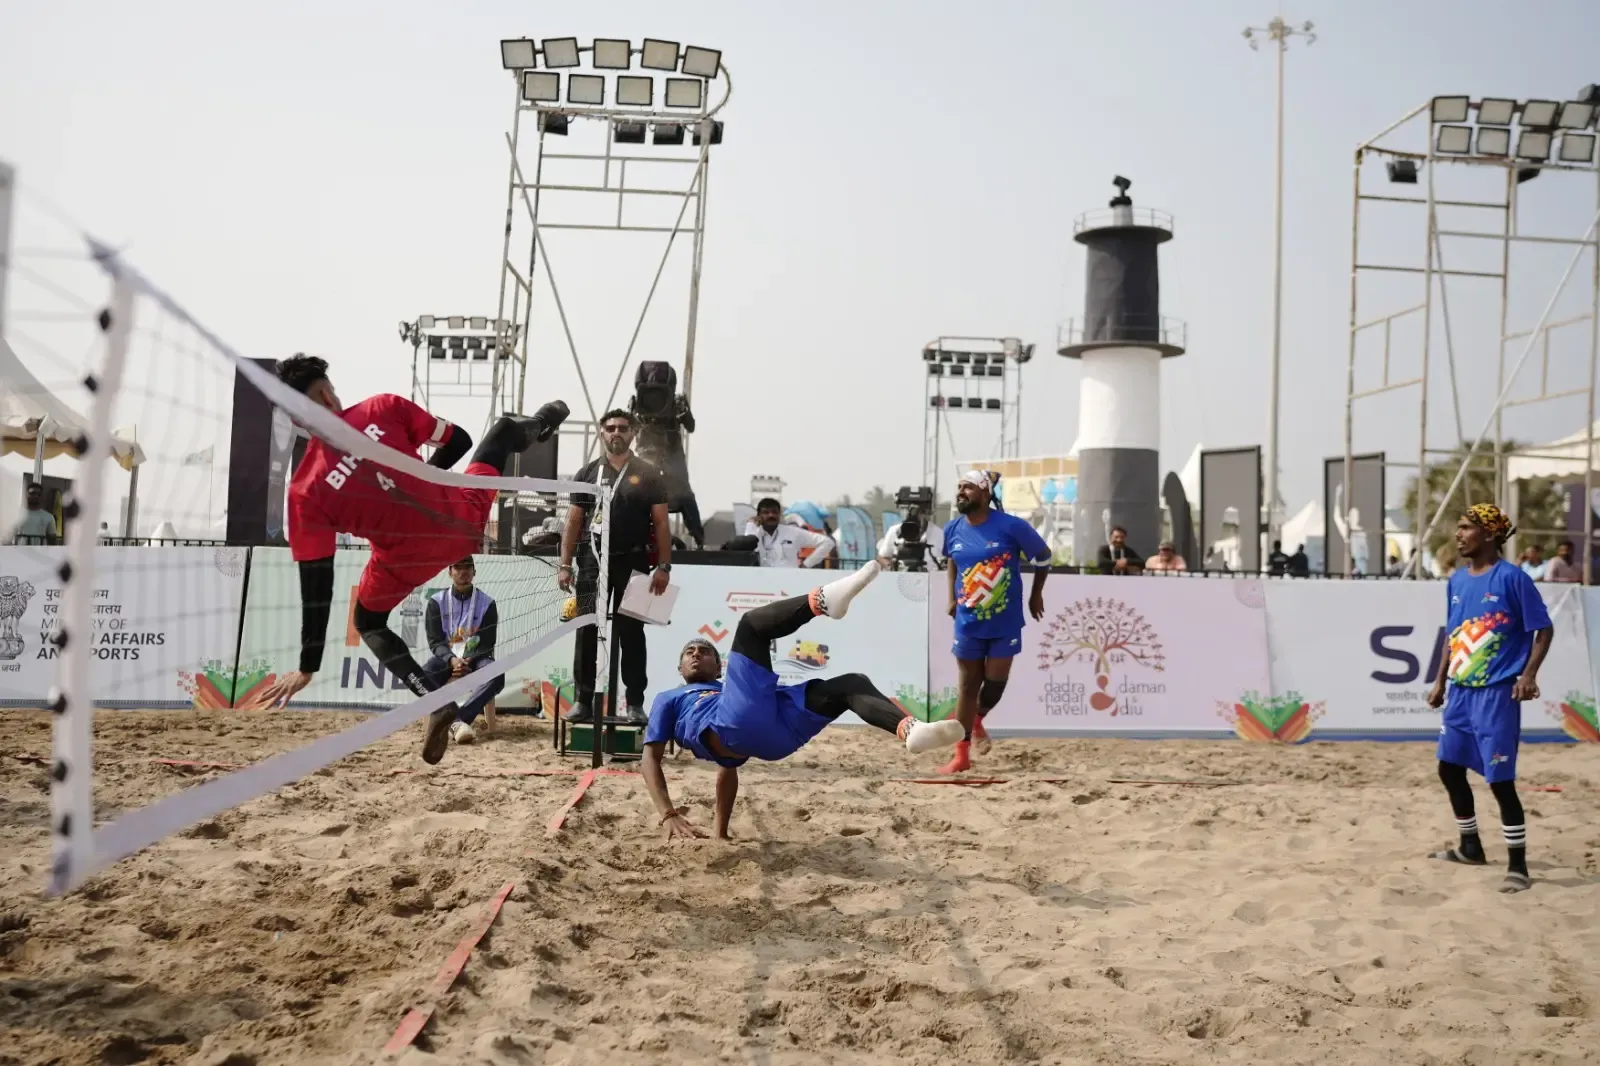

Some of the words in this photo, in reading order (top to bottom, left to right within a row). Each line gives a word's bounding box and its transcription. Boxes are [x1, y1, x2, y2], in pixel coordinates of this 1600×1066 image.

[325, 423, 386, 490] BIHR
[376, 471, 396, 491] 4
[109, 619, 128, 630] OF
[100, 632, 165, 645] AFFAIRS
[91, 648, 140, 660] PORTS
[1044, 674, 1085, 693] dadra
[1119, 674, 1166, 693] daman
[1045, 702, 1088, 716] haveli
[1119, 697, 1143, 716] diu
[1372, 707, 1406, 716] SPORTS
